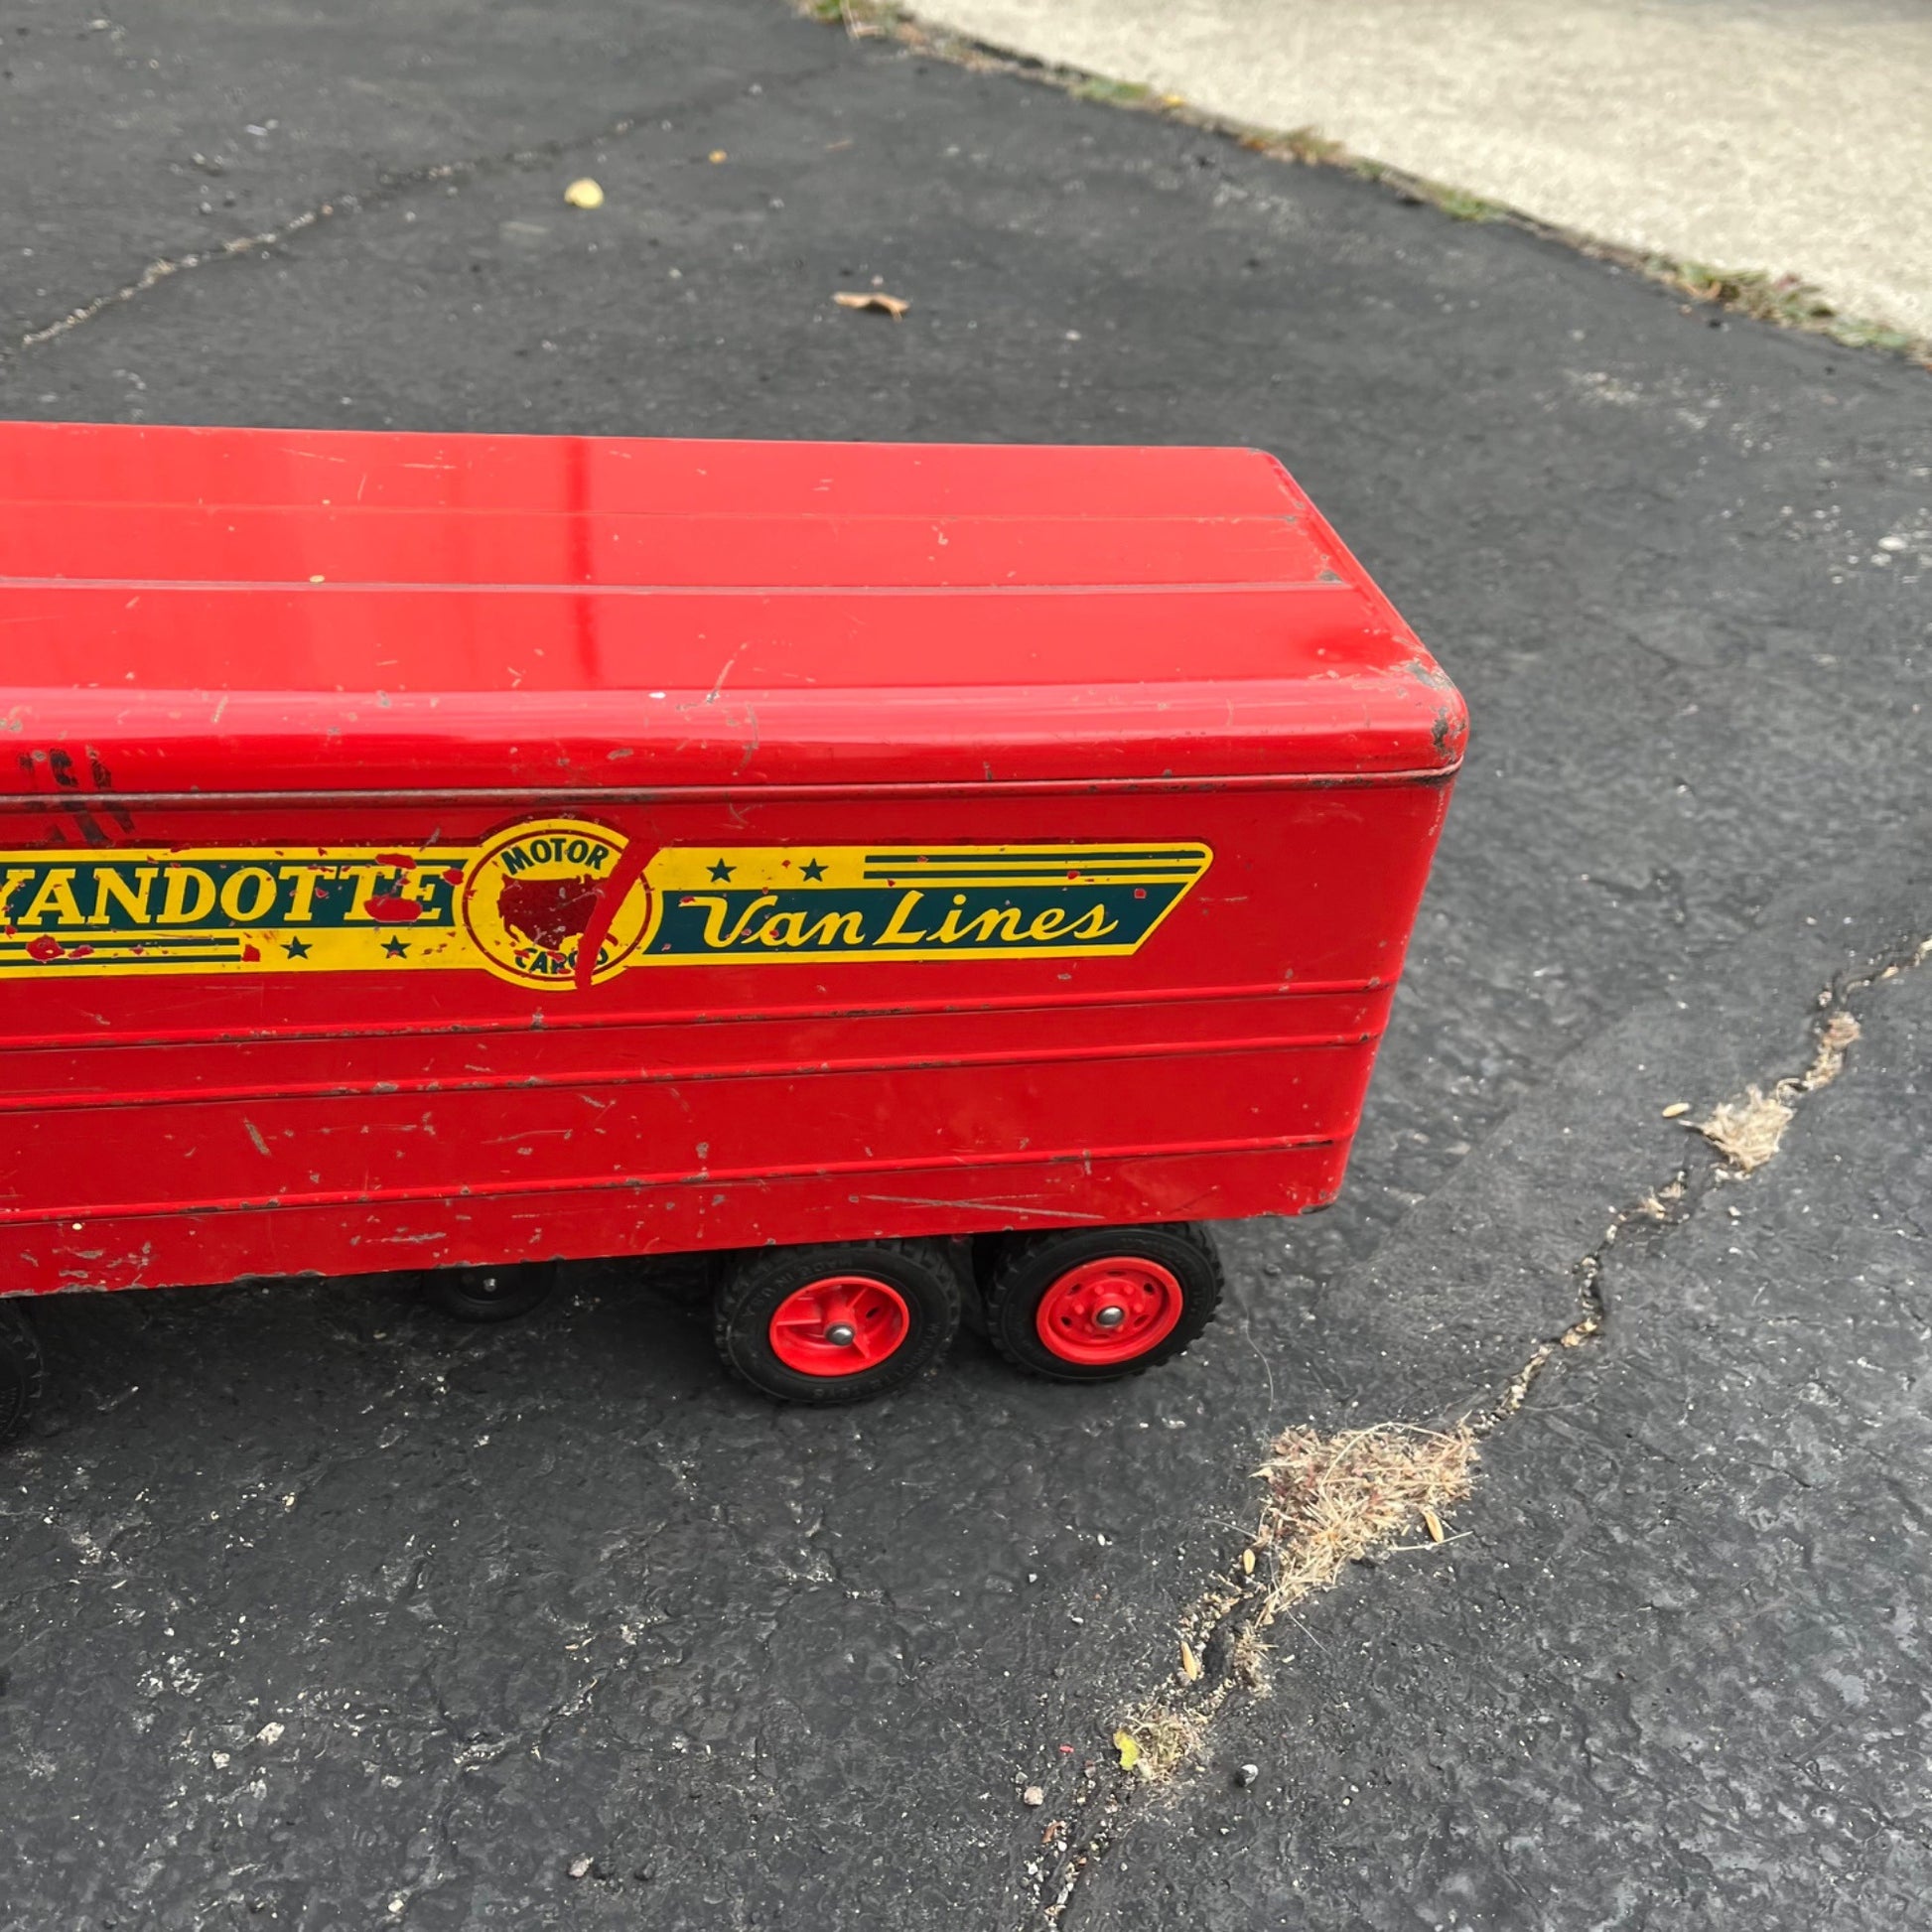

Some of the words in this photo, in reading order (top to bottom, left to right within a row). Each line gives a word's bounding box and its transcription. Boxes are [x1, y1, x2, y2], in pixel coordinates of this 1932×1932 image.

[500, 837, 610, 876] MOTOR
[678, 895, 865, 948] Van
[872, 890, 1119, 945] Lines
